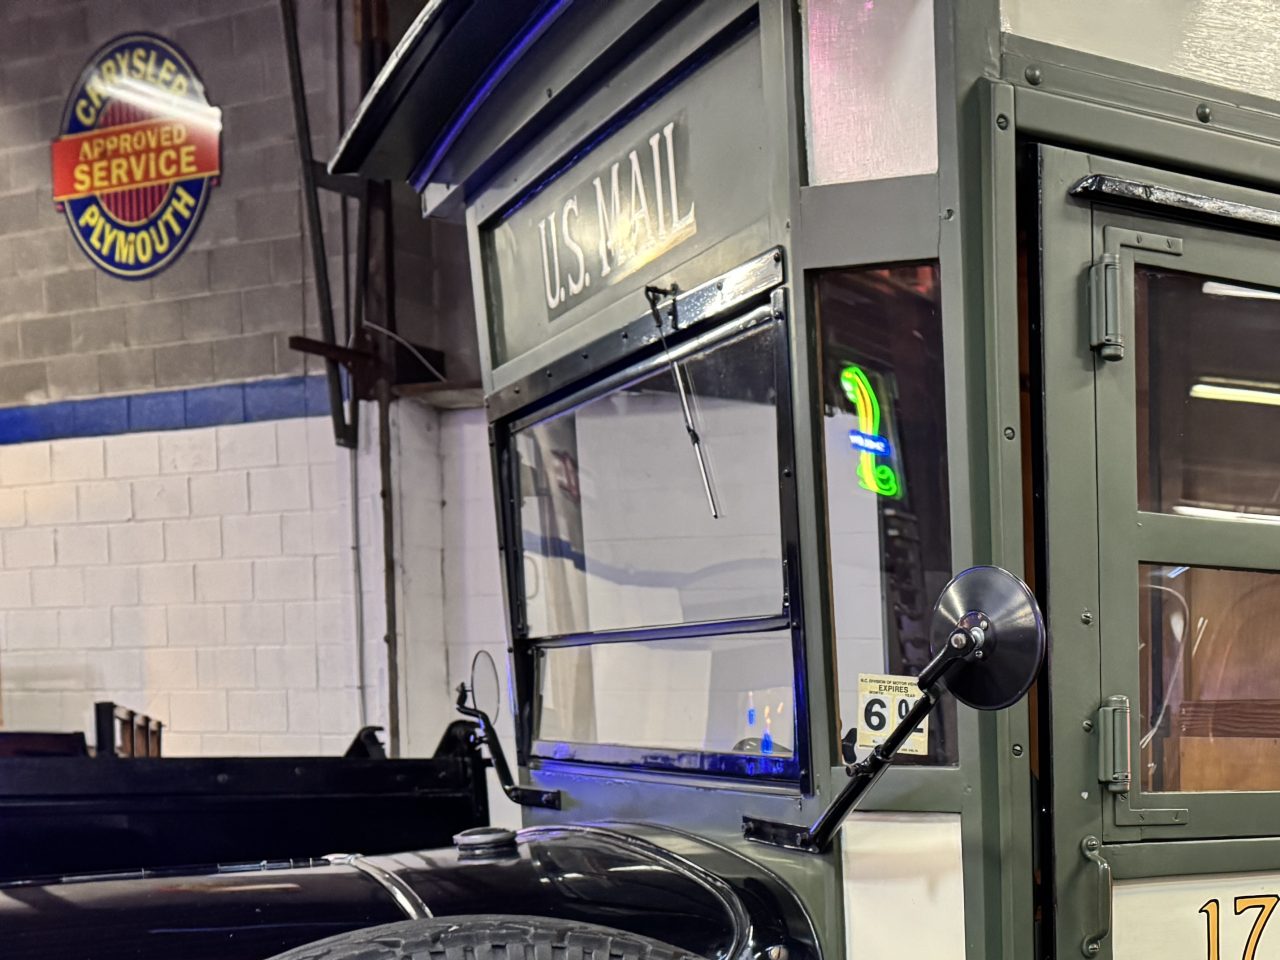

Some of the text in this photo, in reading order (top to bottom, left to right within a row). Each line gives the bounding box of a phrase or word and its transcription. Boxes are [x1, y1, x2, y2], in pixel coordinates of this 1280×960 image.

[79, 124, 188, 162] APPROVED
[73, 145, 198, 192] SERVICE
[593, 121, 694, 278] MAIL
[79, 186, 196, 265] PLYMOUTH
[878, 685, 909, 693] EXPIRES
[864, 698, 887, 731] 6
